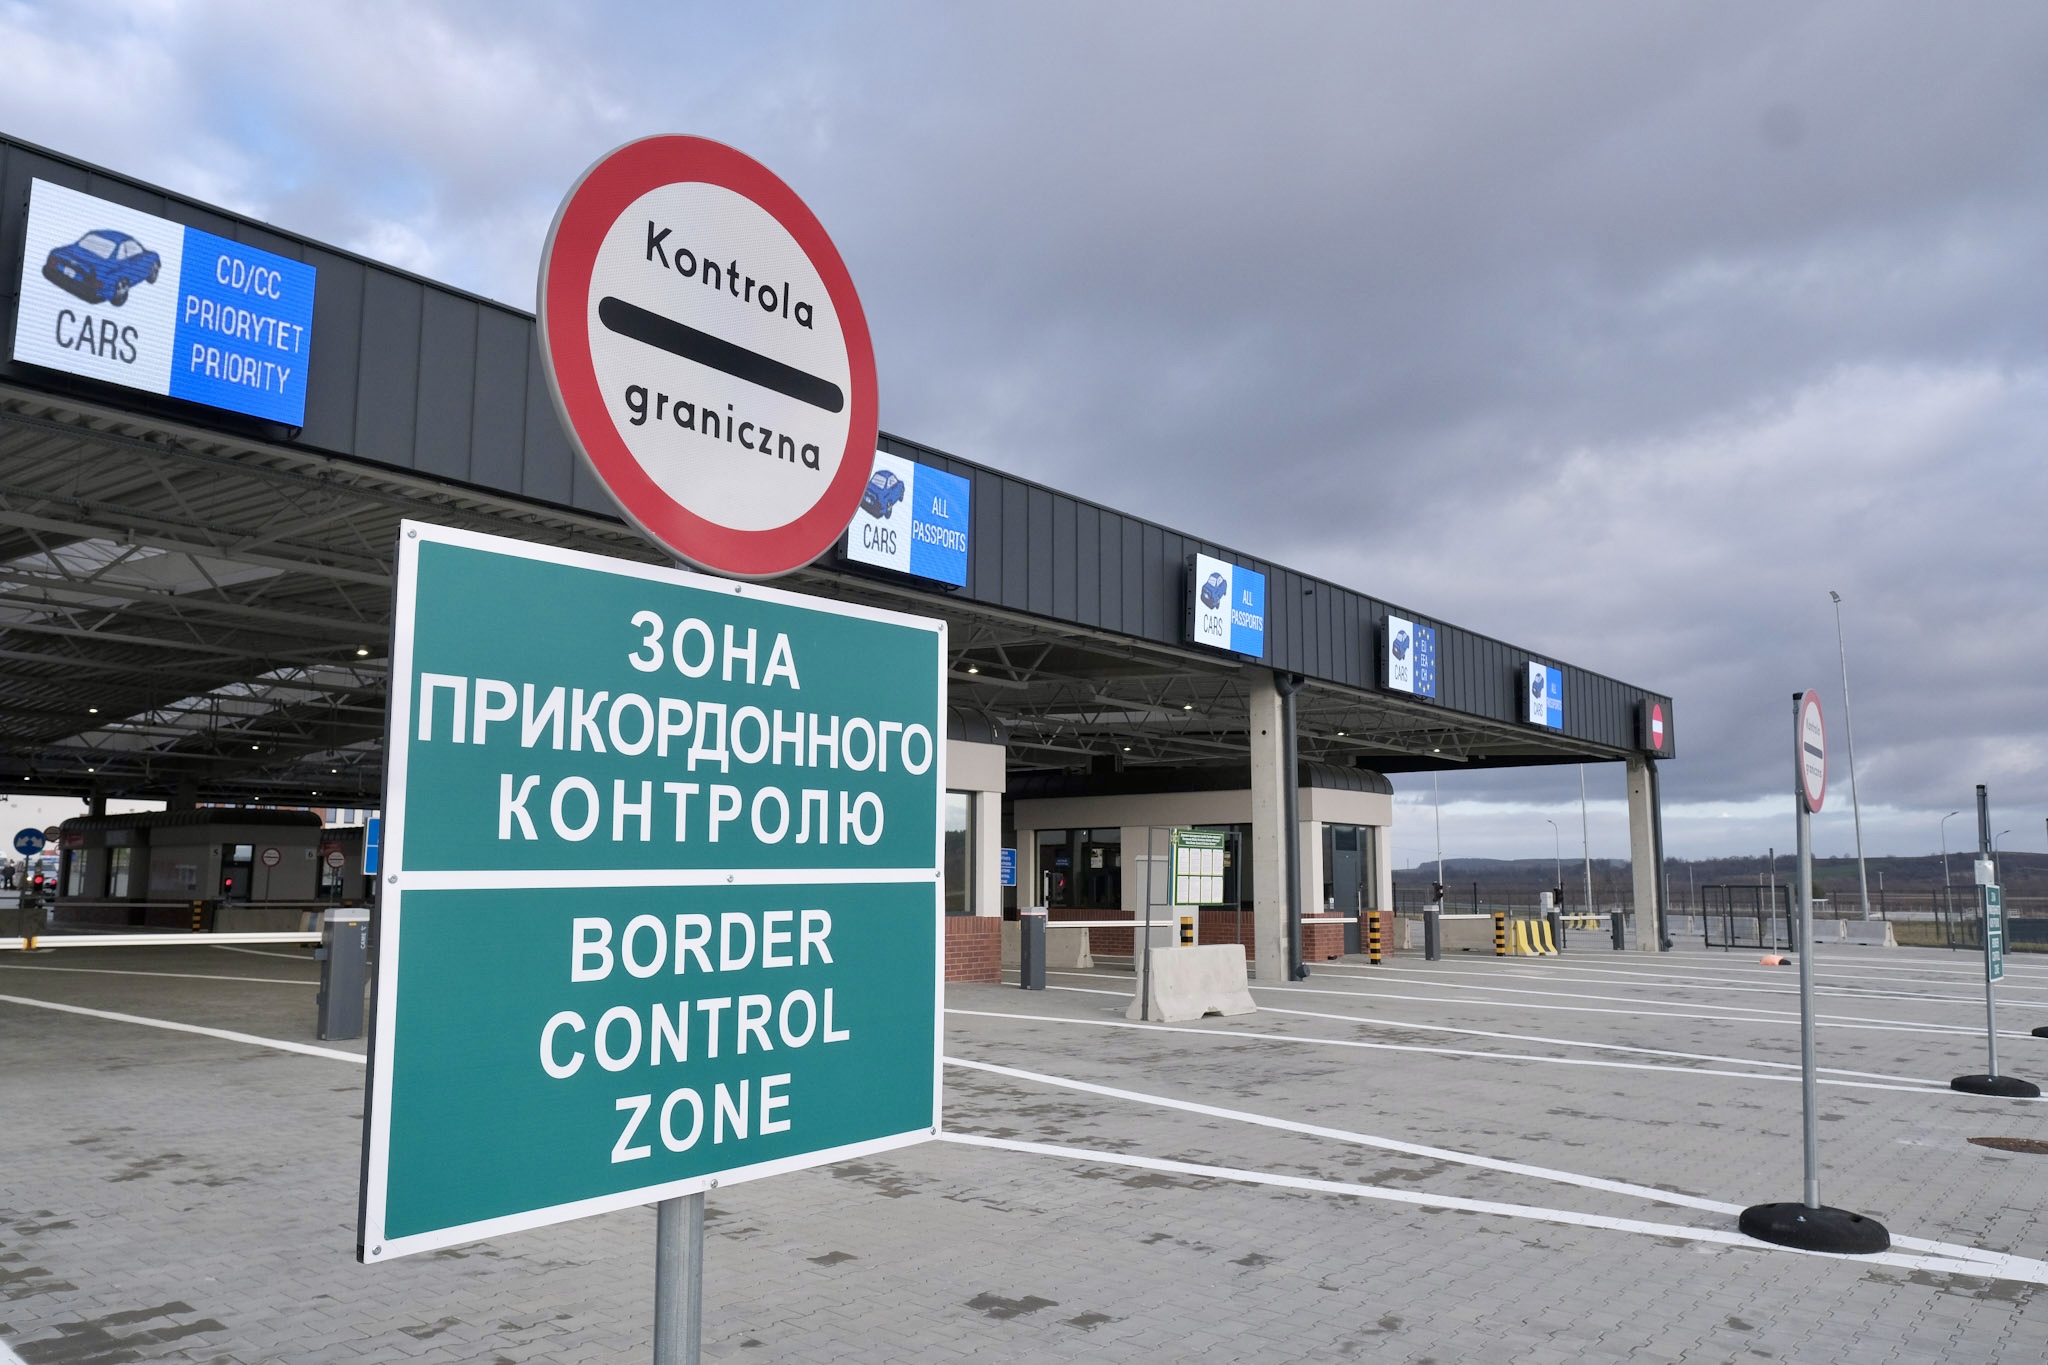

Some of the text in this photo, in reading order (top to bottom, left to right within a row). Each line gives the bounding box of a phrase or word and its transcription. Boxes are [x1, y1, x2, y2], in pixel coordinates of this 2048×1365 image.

[216, 255, 282, 299] CD/CC
[646, 220, 813, 330] Kontrola
[56, 309, 138, 364] CARS
[185, 295, 303, 353] PRIORYTET
[190, 343, 290, 394] PRIORITY
[625, 384, 820, 471] graniczna
[931, 496, 949, 519] ALL
[863, 523, 897, 555] CARS
[912, 520, 966, 553] PASSPORTS
[1203, 614, 1223, 636] CARS
[1231, 609, 1263, 631] PASSPORTS
[1242, 589, 1253, 606] ALL
[628, 610, 800, 690] ЗОНА
[1394, 664, 1408, 682] CARS
[417, 672, 933, 776] ПРИКОРДОННОГО
[498, 773, 885, 845] КОНТРОЛЮ
[571, 909, 834, 983] BORDER
[539, 988, 850, 1079] CONTROL
[611, 1073, 791, 1164] ZONE
